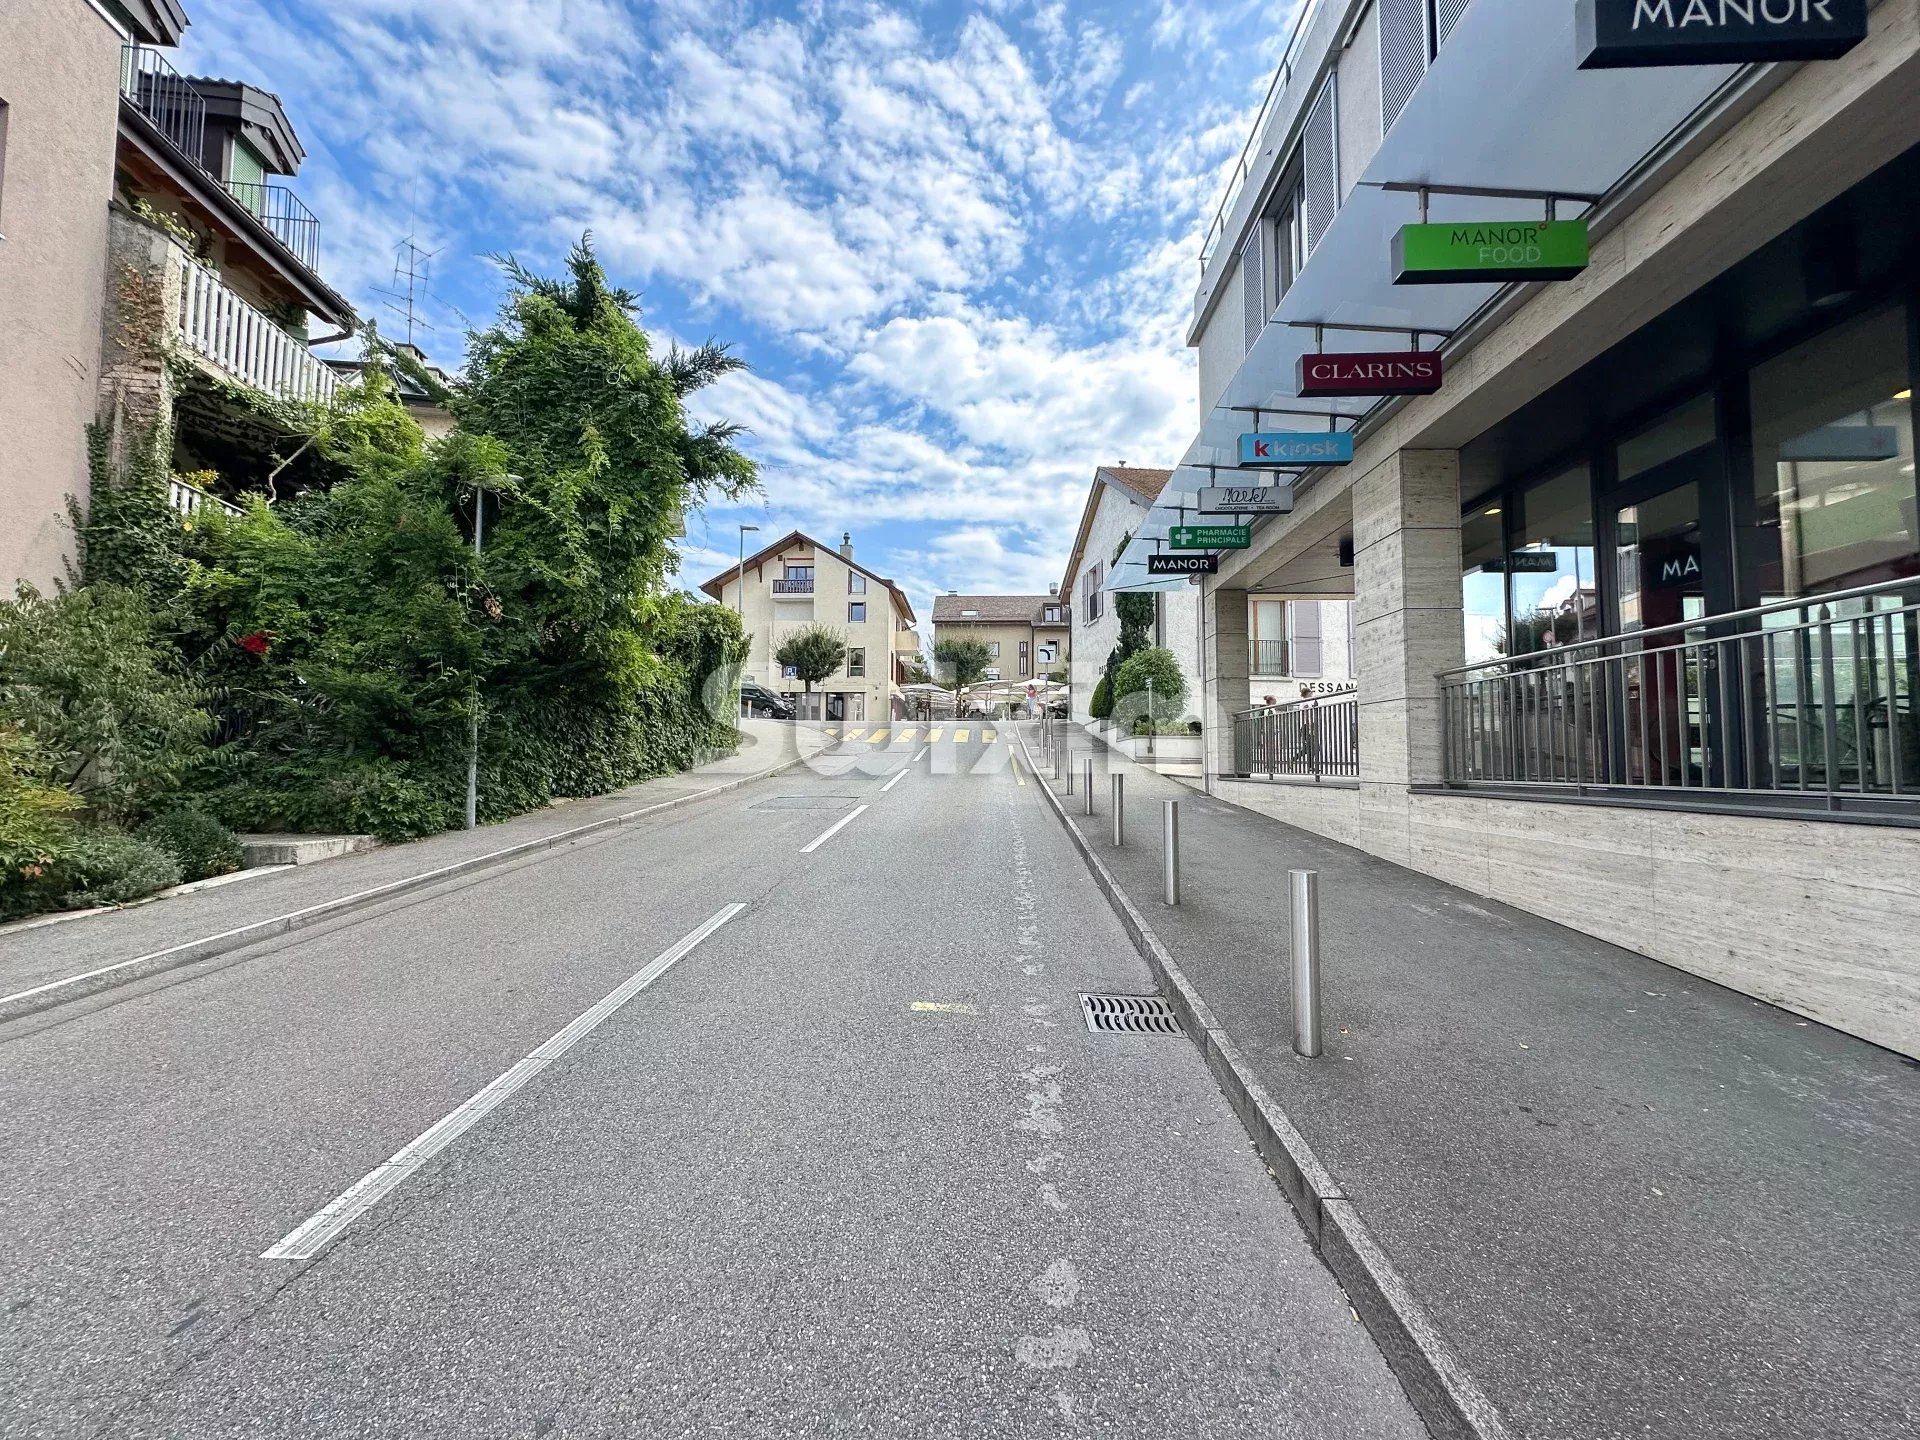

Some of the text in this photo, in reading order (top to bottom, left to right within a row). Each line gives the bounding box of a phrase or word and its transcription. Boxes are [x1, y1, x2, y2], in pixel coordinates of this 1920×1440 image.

[1632, 0, 1834, 30] MANOR
[1450, 227, 1538, 246] MANOR
[1479, 246, 1541, 264] FOOD
[1311, 362, 1433, 380] CLARINS
[1274, 439, 1339, 457] kiosk
[1196, 528, 1247, 536] PHARMACIE
[1196, 536, 1247, 544] PRINCIPALE
[1153, 559, 1209, 570] MANOR
[1299, 682, 1358, 693] DESSAN
